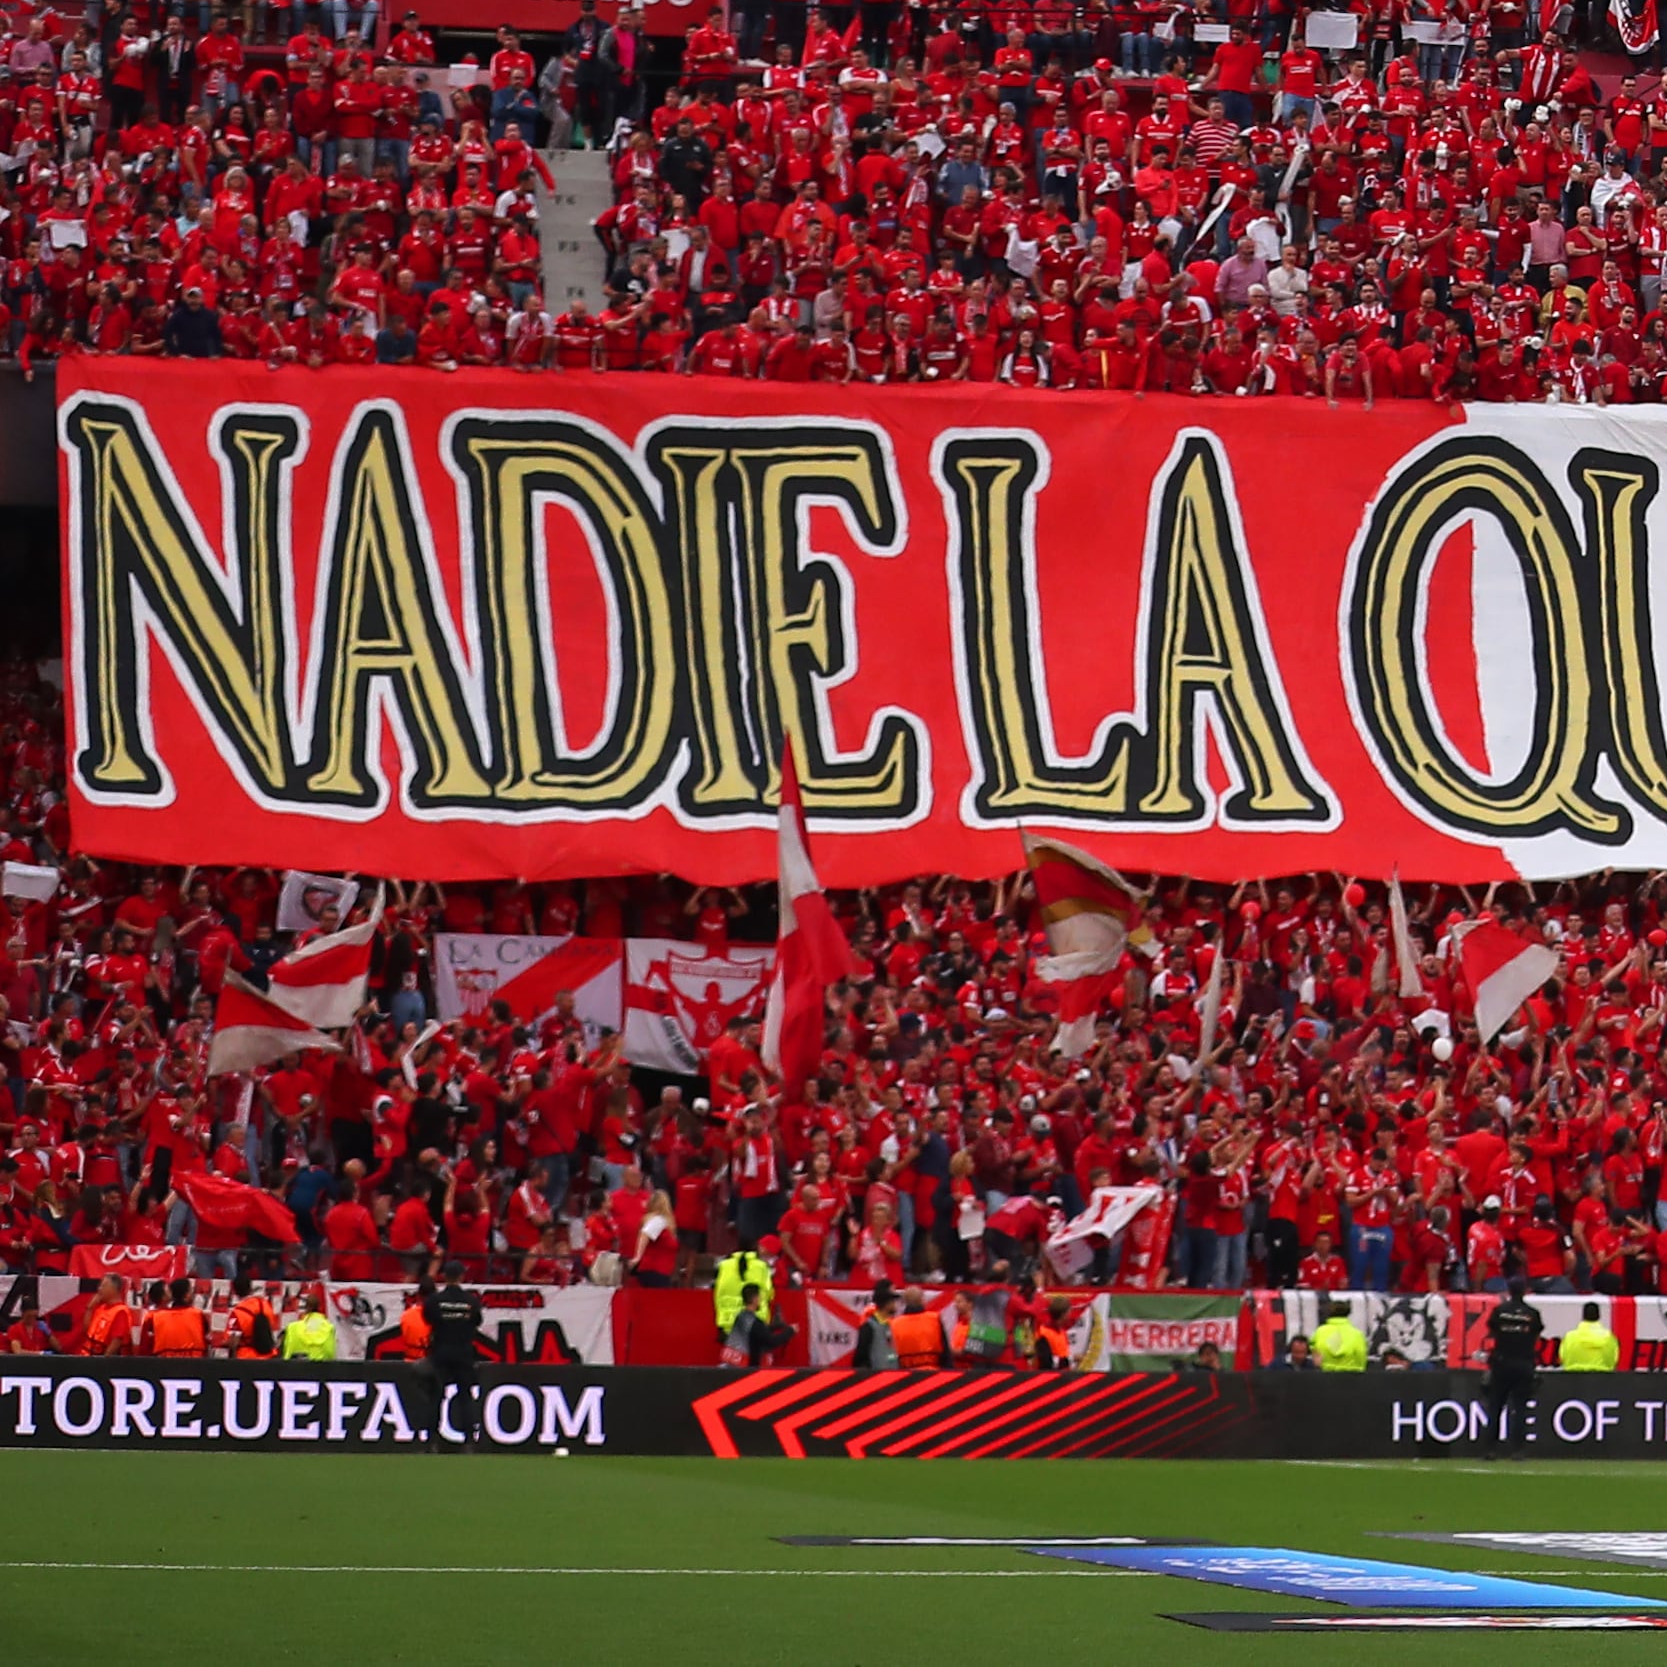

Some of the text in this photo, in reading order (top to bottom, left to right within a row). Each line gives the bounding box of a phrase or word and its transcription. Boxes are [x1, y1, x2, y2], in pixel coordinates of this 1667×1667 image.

[60, 398, 930, 829] NADIE
[938, 428, 1340, 830] LA
[1110, 1320, 1234, 1350] HERRERA
[1553, 1400, 1621, 1444] OF
